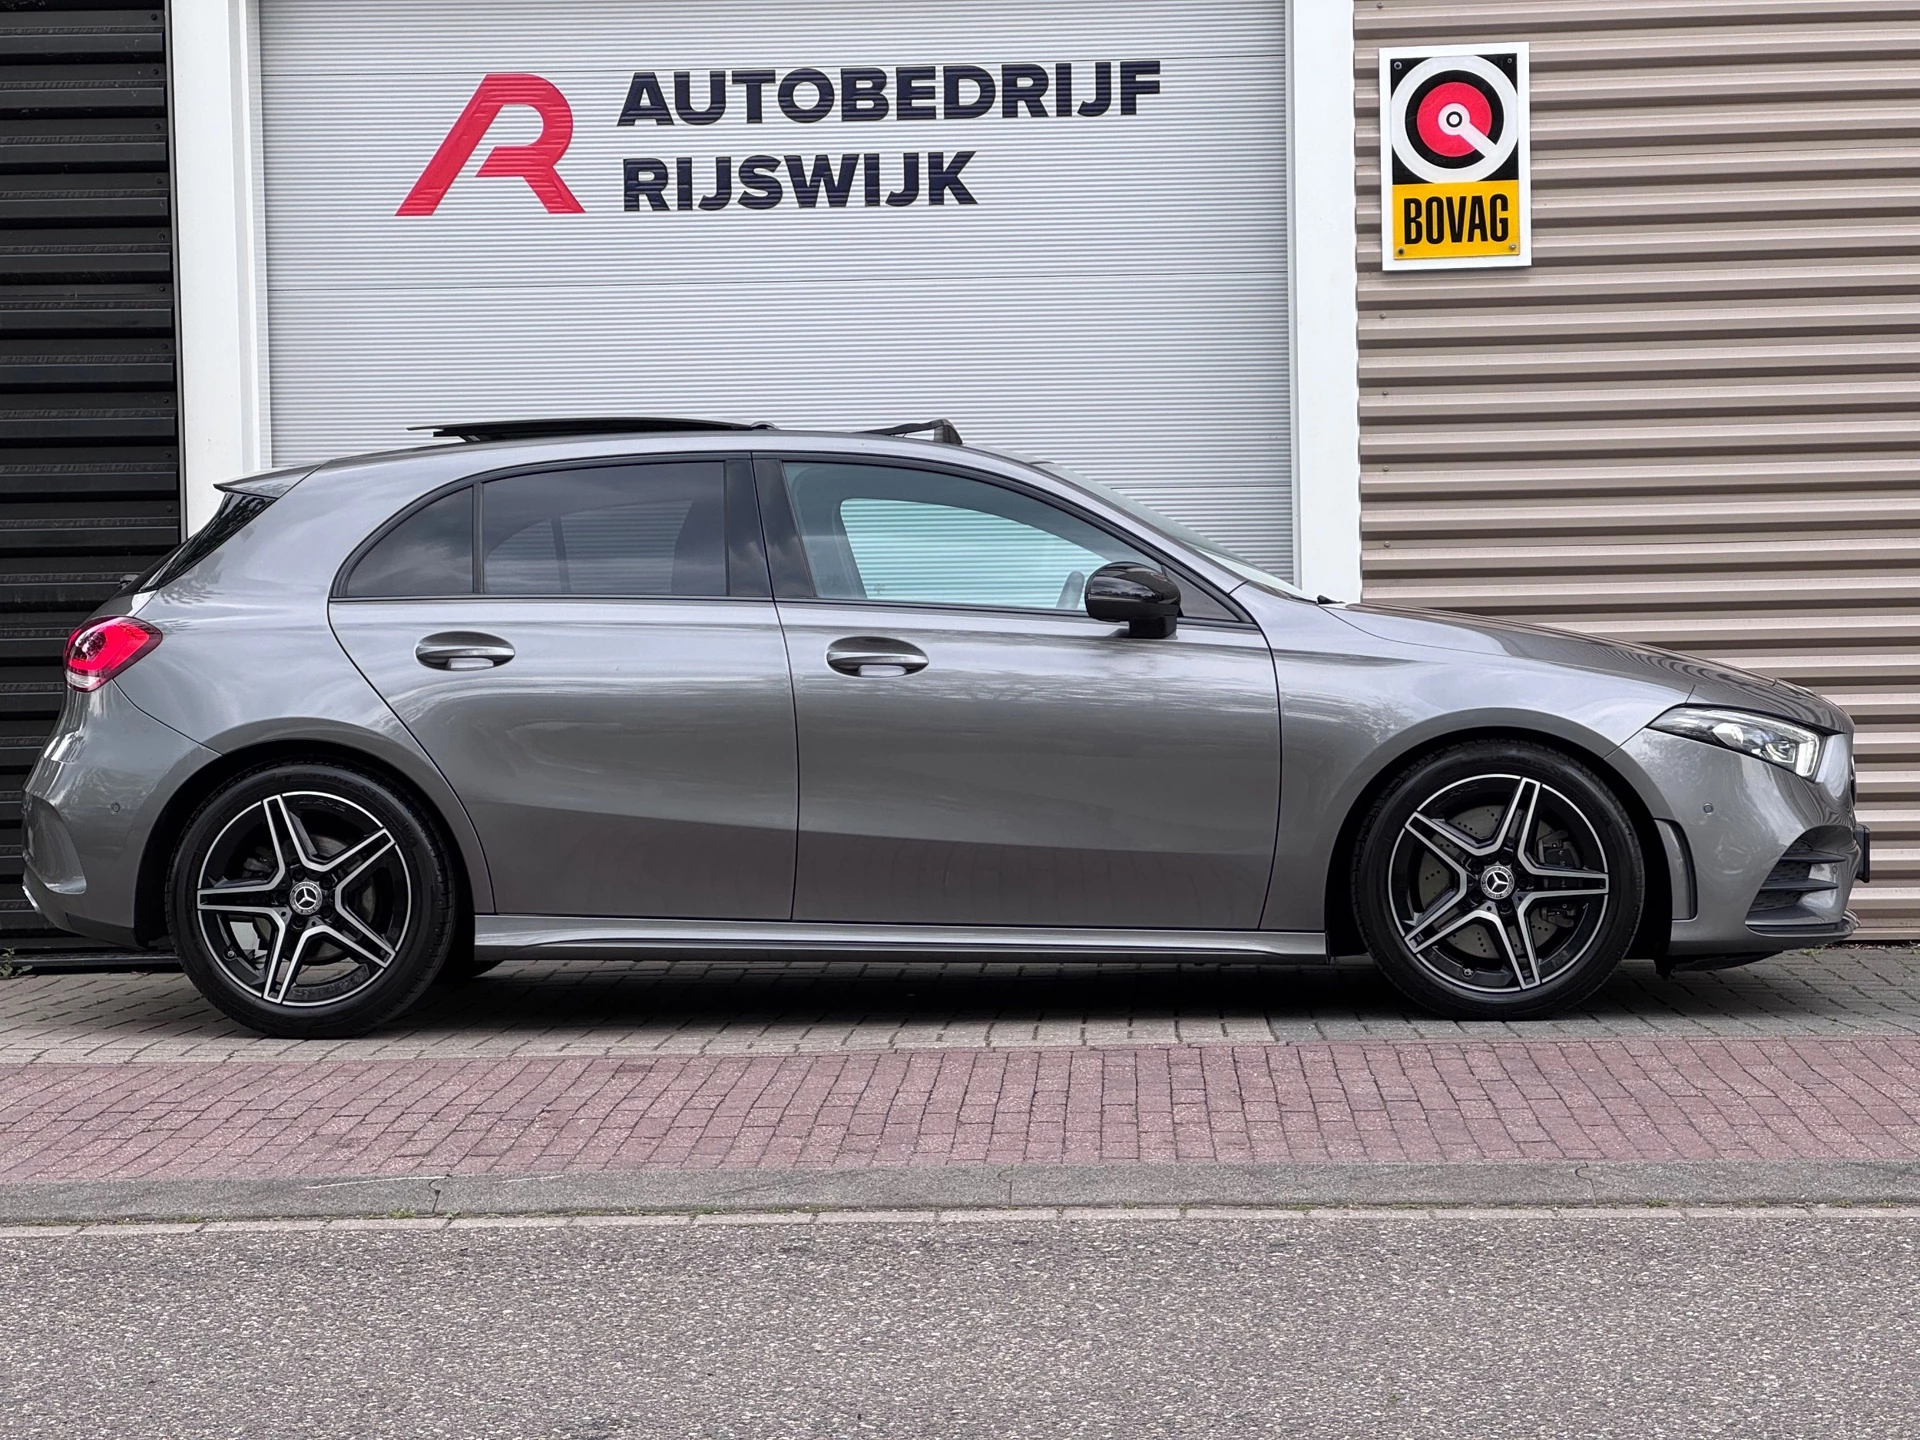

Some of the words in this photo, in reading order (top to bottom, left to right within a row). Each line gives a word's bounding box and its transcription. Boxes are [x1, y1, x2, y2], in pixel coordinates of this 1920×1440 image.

[617, 61, 1161, 127] AUTOBEDRIJF
[623, 151, 979, 212] RIJSWIJK
[1403, 193, 1509, 245] BOVAG
